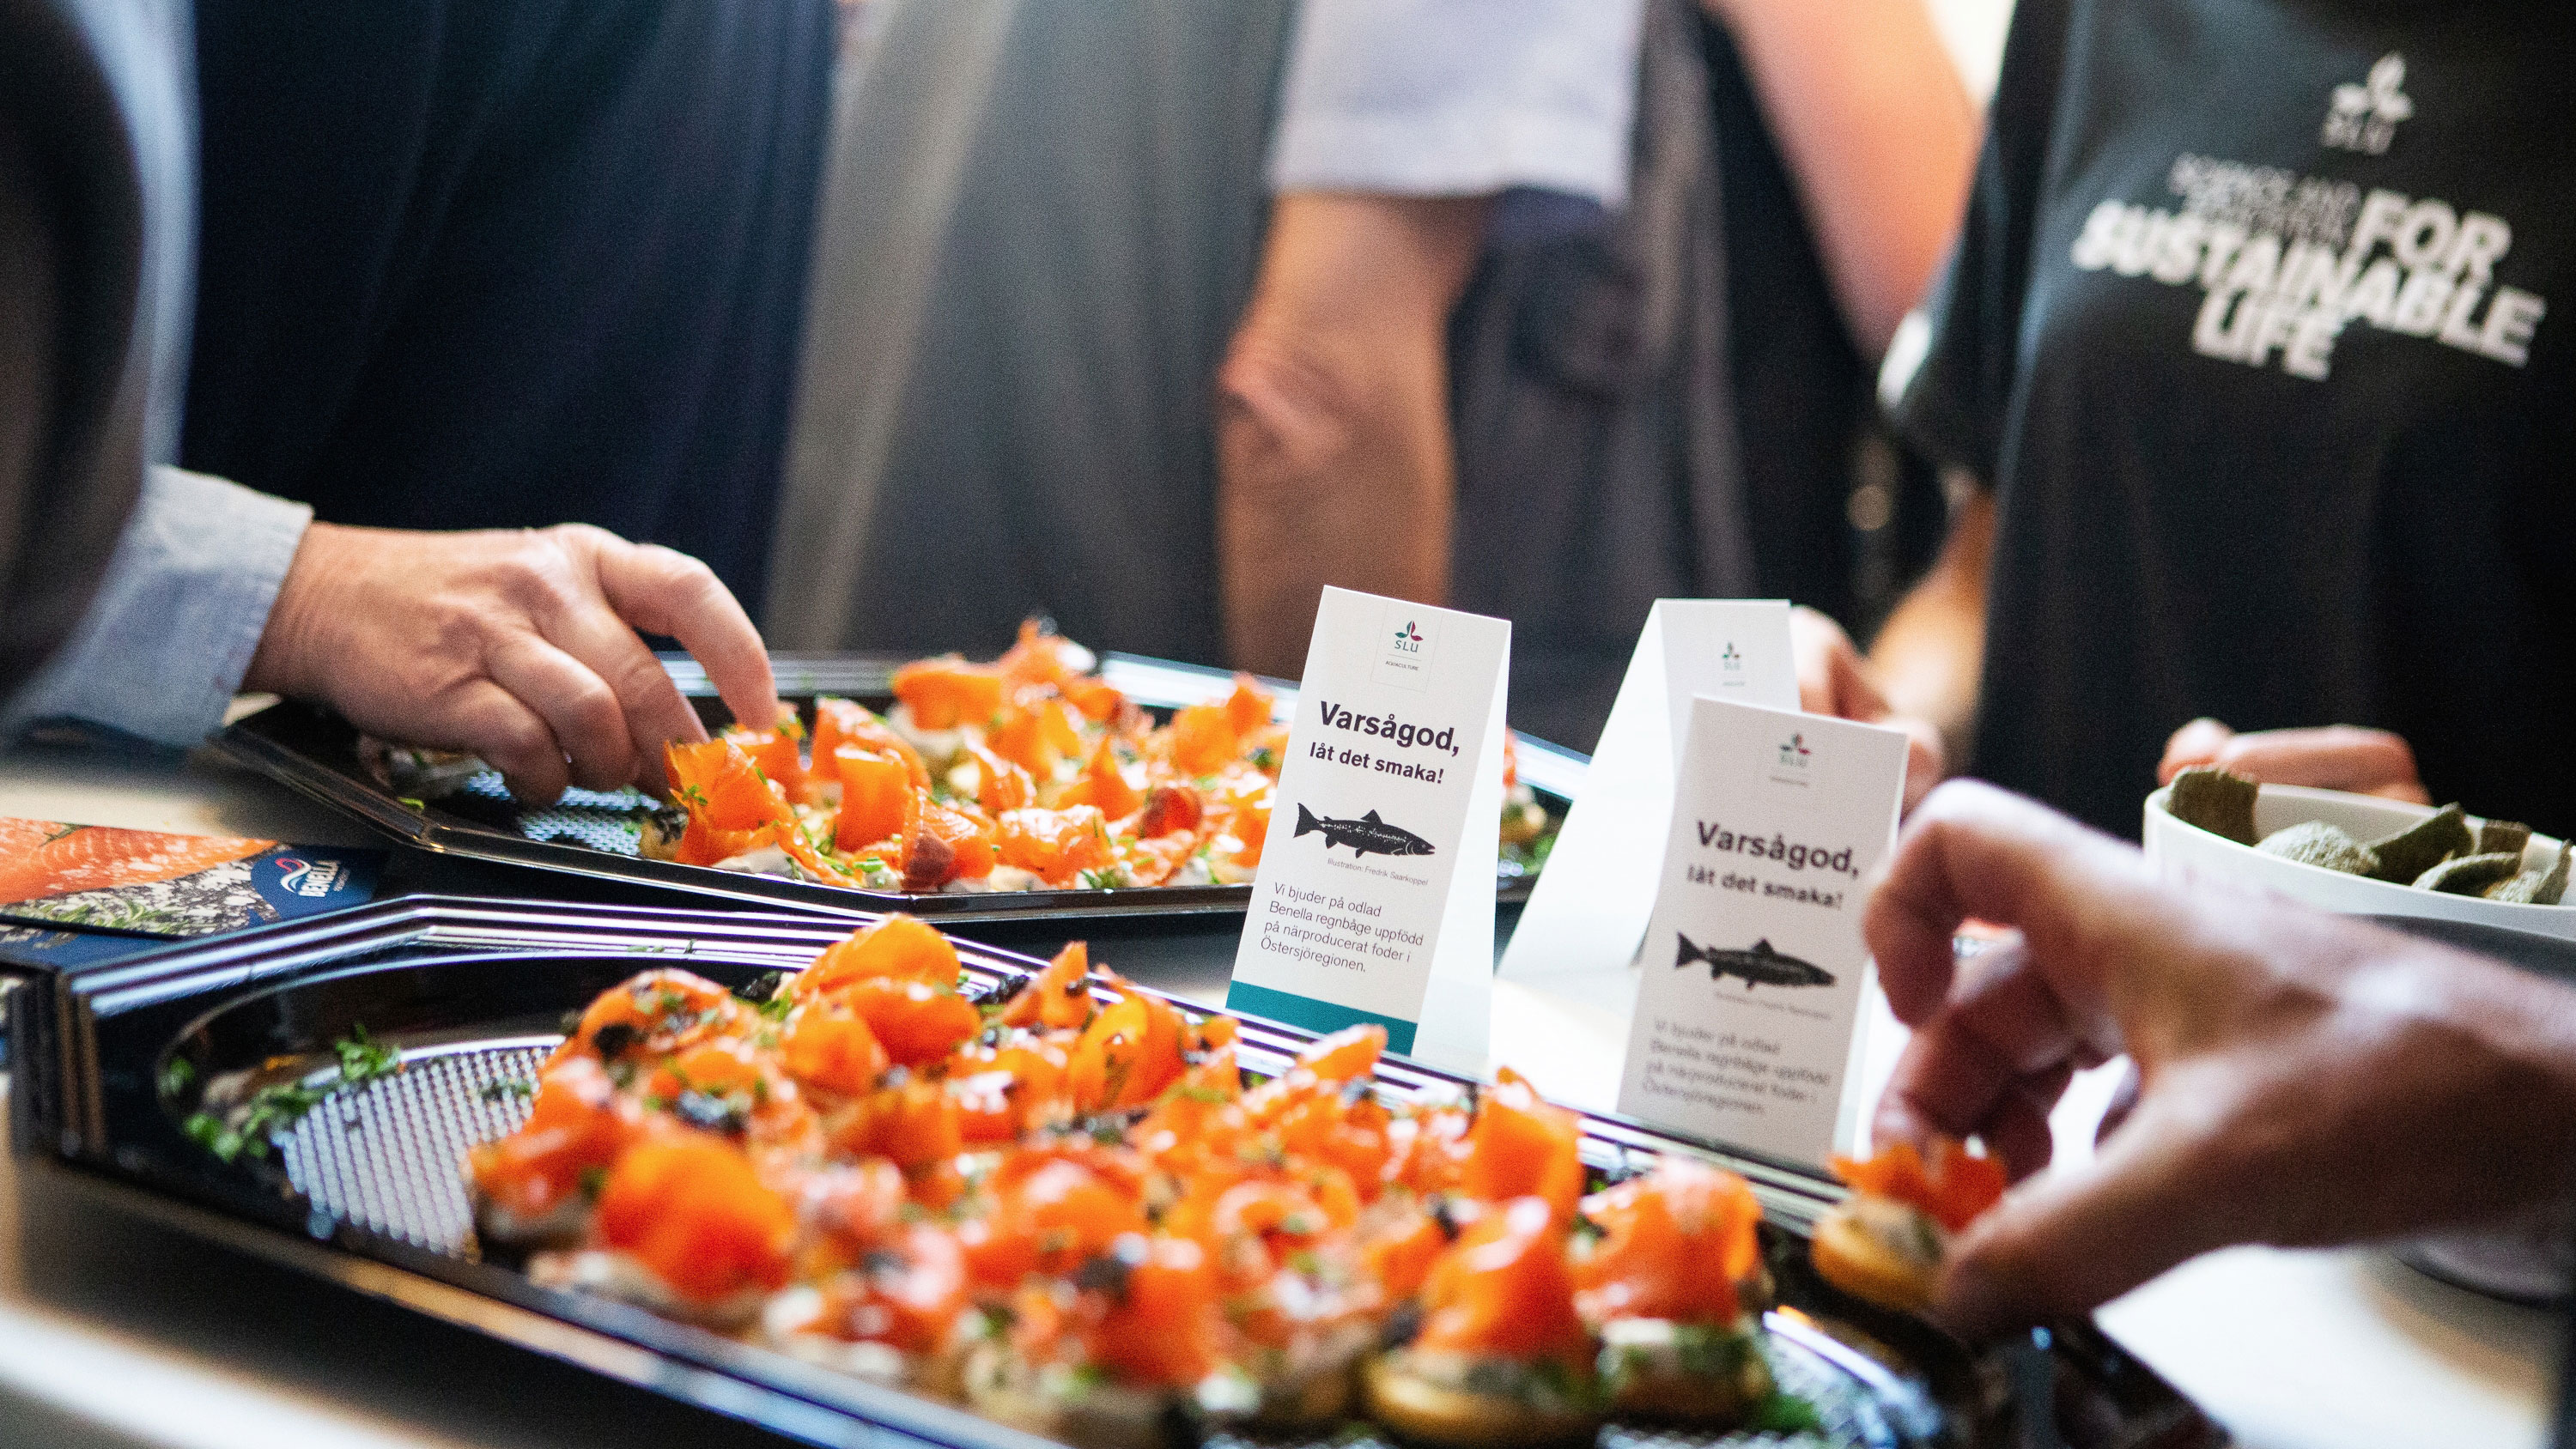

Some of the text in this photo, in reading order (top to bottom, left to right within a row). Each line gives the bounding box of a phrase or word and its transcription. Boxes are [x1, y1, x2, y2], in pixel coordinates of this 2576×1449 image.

[2351, 190, 2512, 284] FOR
[2071, 198, 2547, 368] SUSTAINABLE
[2193, 288, 2335, 381] LIFE
[1394, 640, 1419, 653] SLU
[1320, 700, 1461, 758] Varsågod,
[1309, 742, 1444, 785] låt det smaka!
[1698, 820, 1860, 881] Varsågod,
[1327, 858, 1429, 887] Illustration: Fredrik Saarkoppel
[1721, 872, 1757, 894] det
[1274, 882, 1382, 918] Vi bjuder på odlad
[1264, 921, 1279, 934] på
[1283, 925, 1369, 954] närproducerat
[1371, 943, 1405, 961] foder
[1269, 900, 1424, 946] Benella regnbåge uppfödd
[1261, 935, 1366, 973] Östersjöregionen.
